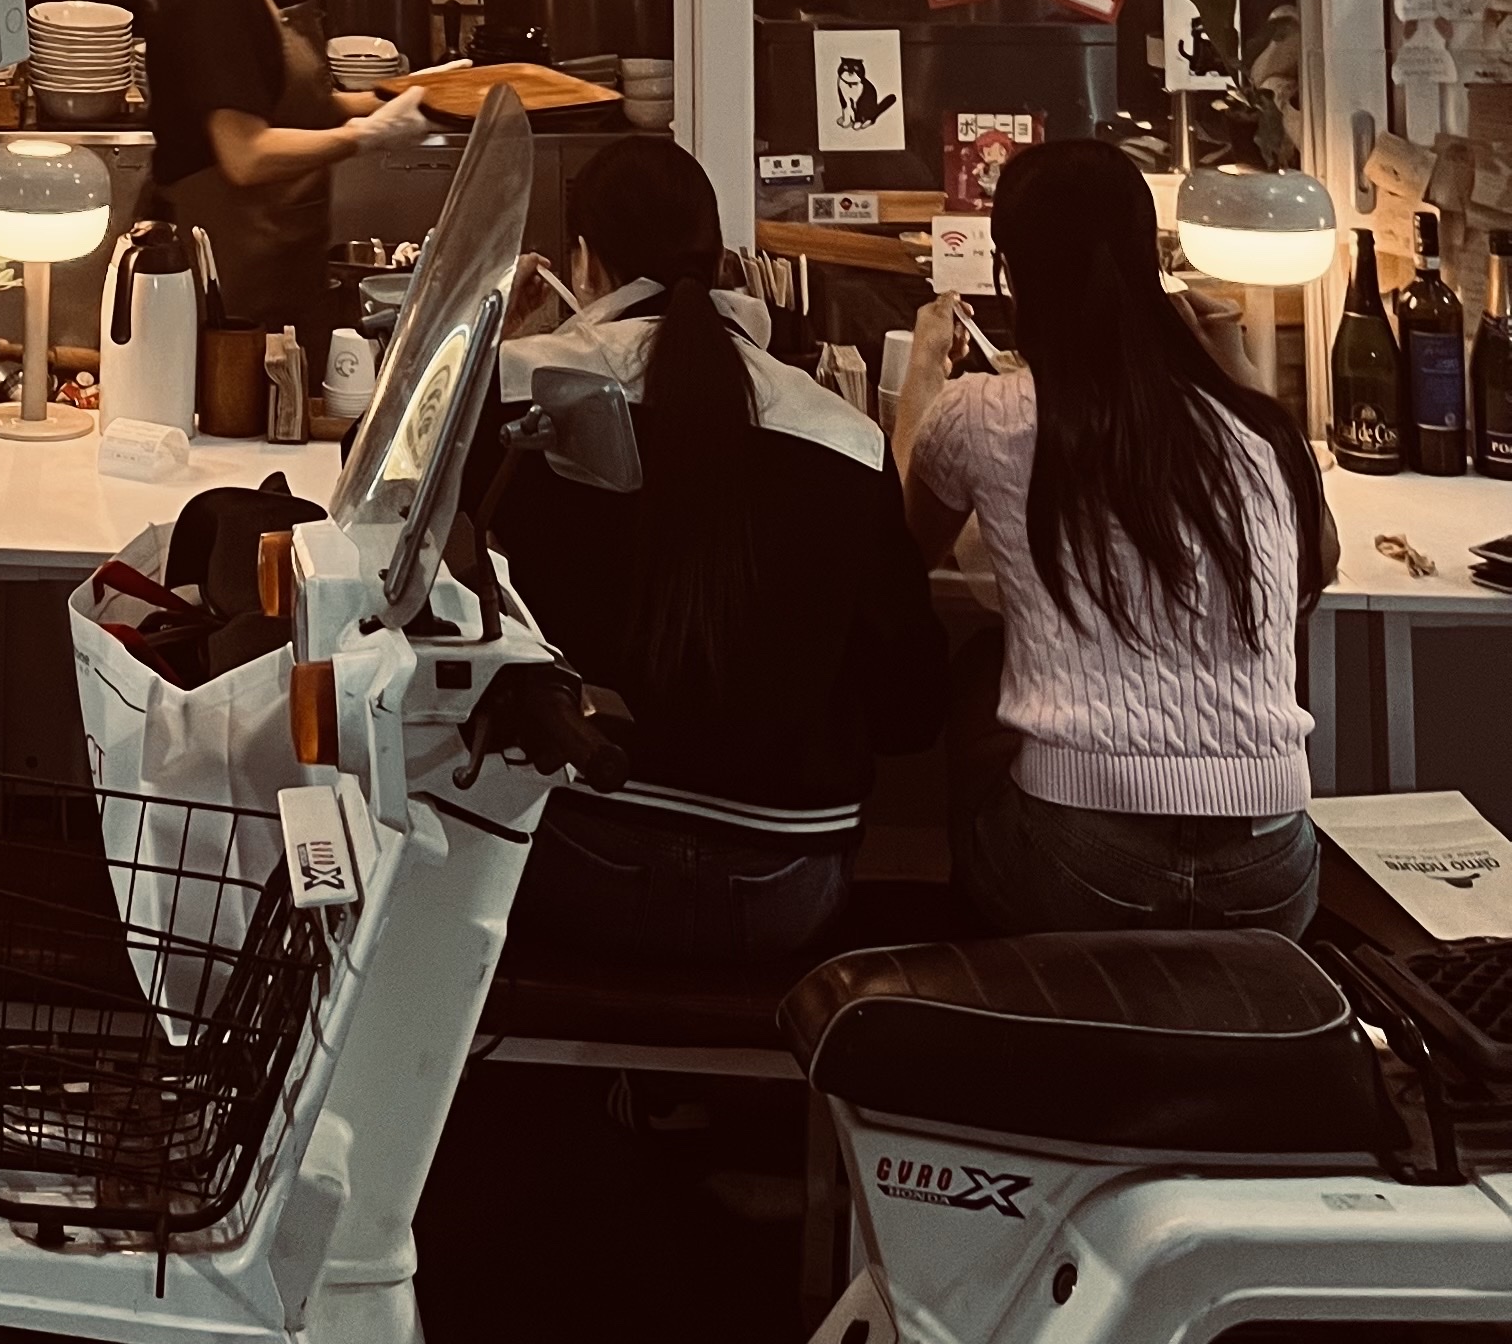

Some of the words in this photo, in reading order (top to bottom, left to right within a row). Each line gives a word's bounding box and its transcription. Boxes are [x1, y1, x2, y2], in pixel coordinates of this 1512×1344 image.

[1385, 861, 1450, 873] nature
[1450, 858, 1500, 871] almo
[888, 1187, 951, 1205] HONDA
[960, 1166, 1033, 1219] X
